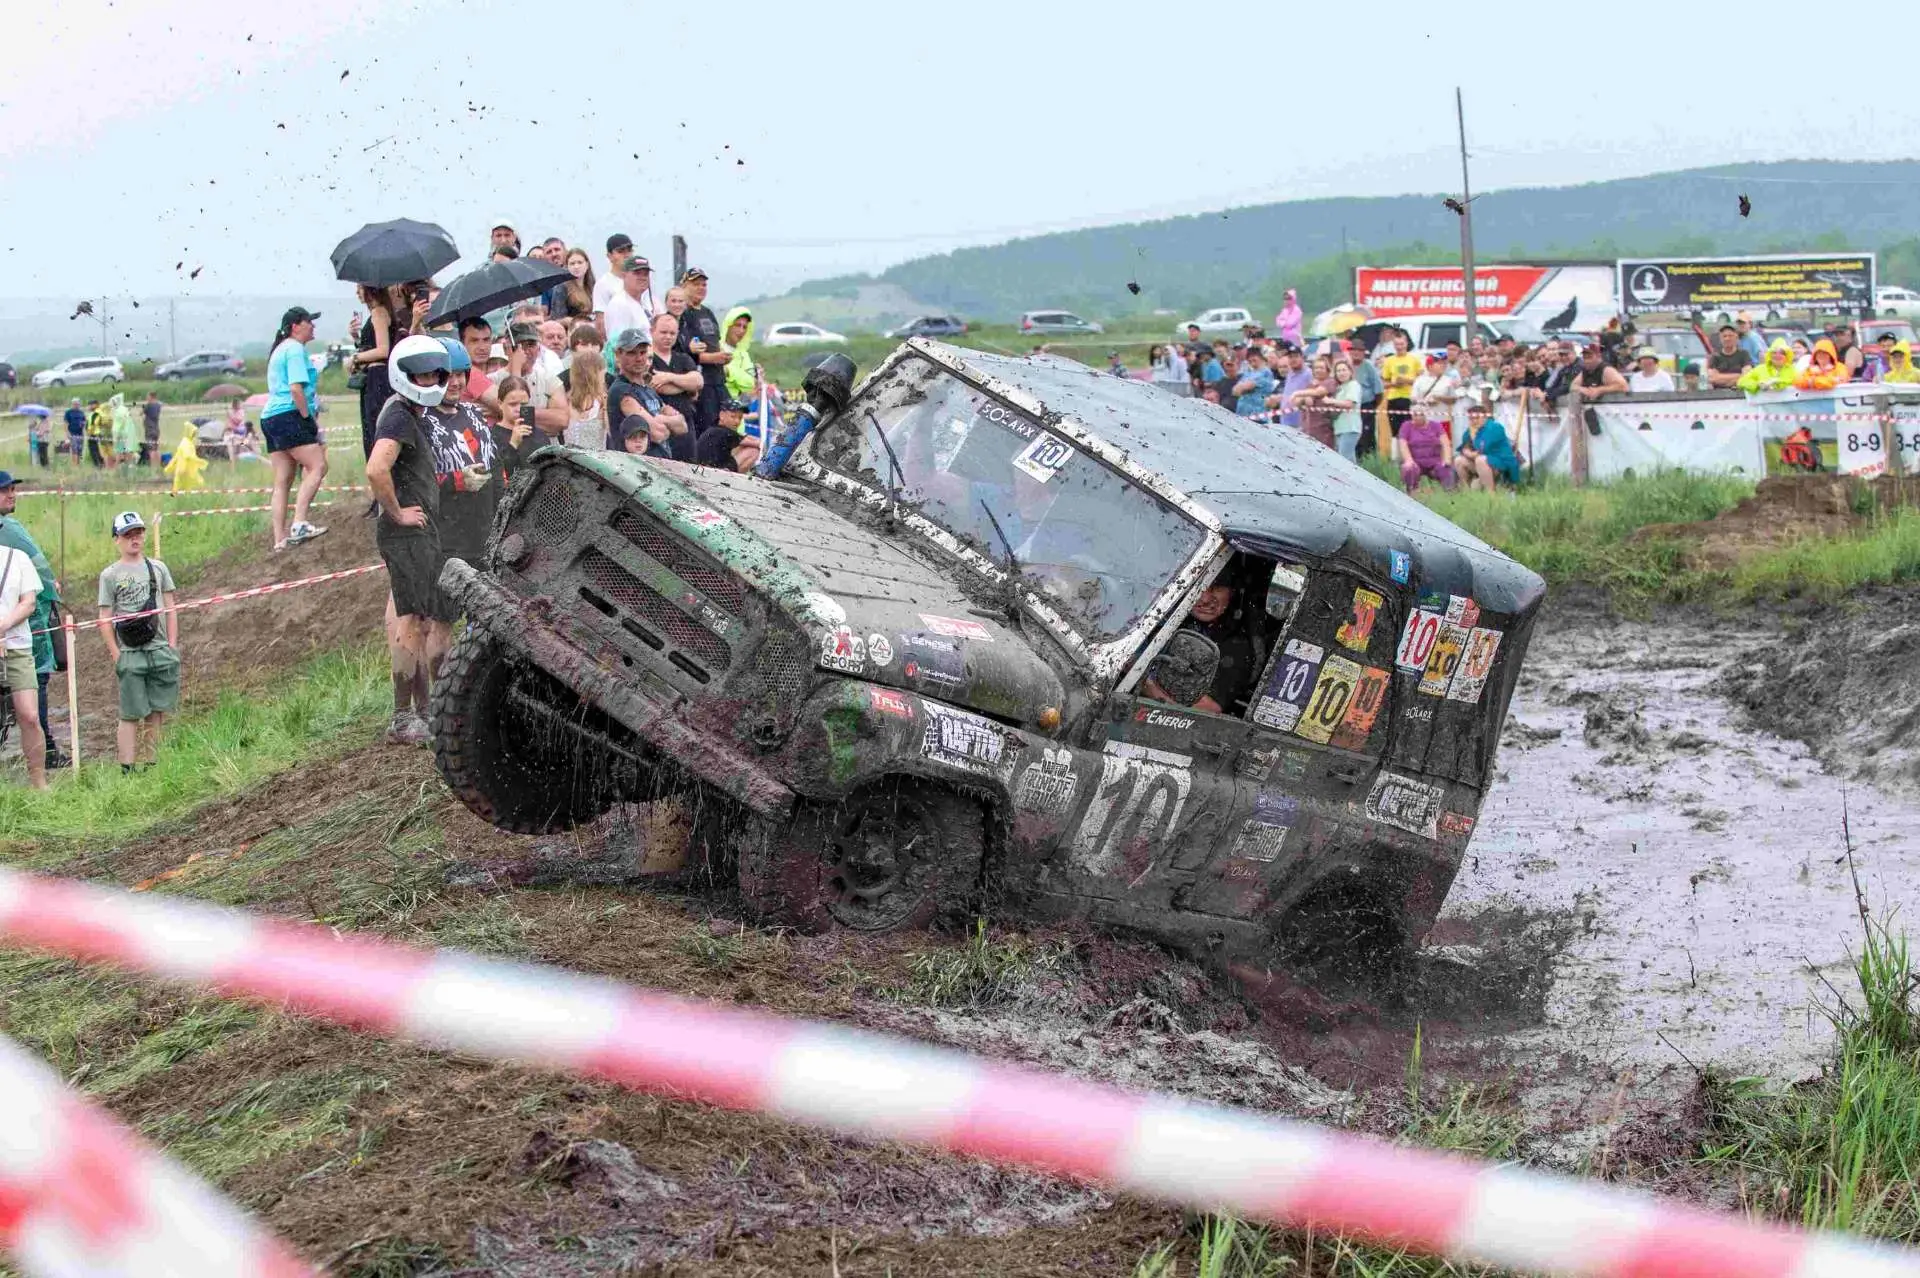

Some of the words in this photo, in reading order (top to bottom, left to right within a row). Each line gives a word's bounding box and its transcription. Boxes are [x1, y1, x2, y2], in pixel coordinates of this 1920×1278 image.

[1364, 295, 1414, 308] ЗАВОД
[1418, 295, 1508, 309] ПРИЦПОВ
[1371, 276, 1498, 292] МИНУСИНСИЙ
[1034, 440, 1065, 467] 10
[1401, 610, 1438, 665] 10
[1278, 661, 1310, 702] 10
[1309, 677, 1351, 726] 10
[1092, 765, 1180, 872] 10
